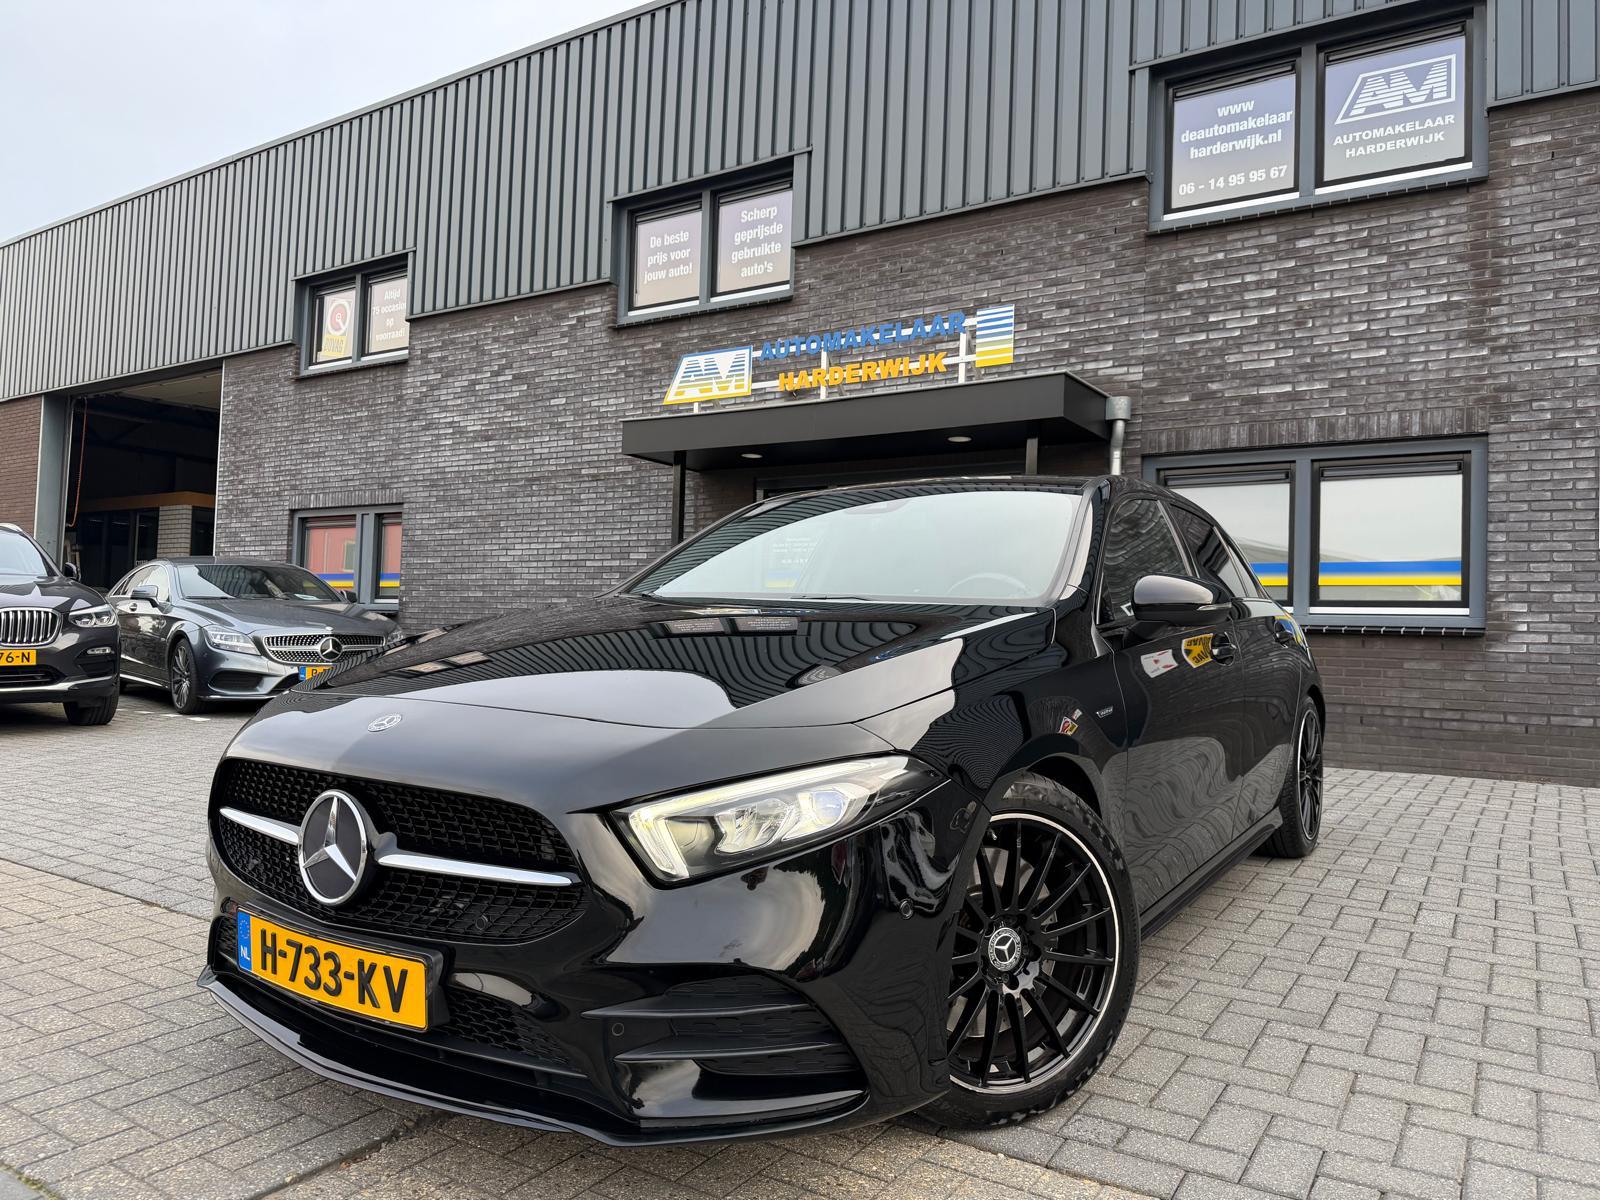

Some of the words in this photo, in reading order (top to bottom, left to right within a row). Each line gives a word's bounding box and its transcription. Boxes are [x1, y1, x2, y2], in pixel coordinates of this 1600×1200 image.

[1217, 100, 1255, 118] www
[1181, 110, 1294, 143] deautomakelaar
[1332, 114, 1456, 146] AUTOMAKELAAR
[1189, 130, 1283, 160] harderwijk.nl
[1345, 130, 1446, 159] HARDERWIJK
[1178, 181, 1195, 196] 06
[1208, 176, 1225, 191] 14
[1228, 173, 1246, 187] 95
[1249, 169, 1267, 183] 95
[1269, 164, 1288, 180] 67
[740, 206, 778, 223] Scherp
[649, 235, 662, 249] De
[664, 230, 690, 245] beste
[734, 222, 784, 246] geprijsde
[647, 252, 668, 267] prijs
[670, 247, 691, 260] voor
[731, 242, 782, 264] gebruikte
[643, 270, 667, 285] jouw
[668, 262, 693, 278] auto!
[740, 261, 774, 279] auto's
[758, 311, 967, 362] AUTOMAKELAAR
[777, 351, 949, 393] HARDERWIJK
[240, 945, 250, 961] NL
[260, 927, 409, 1014] H-733-KV
